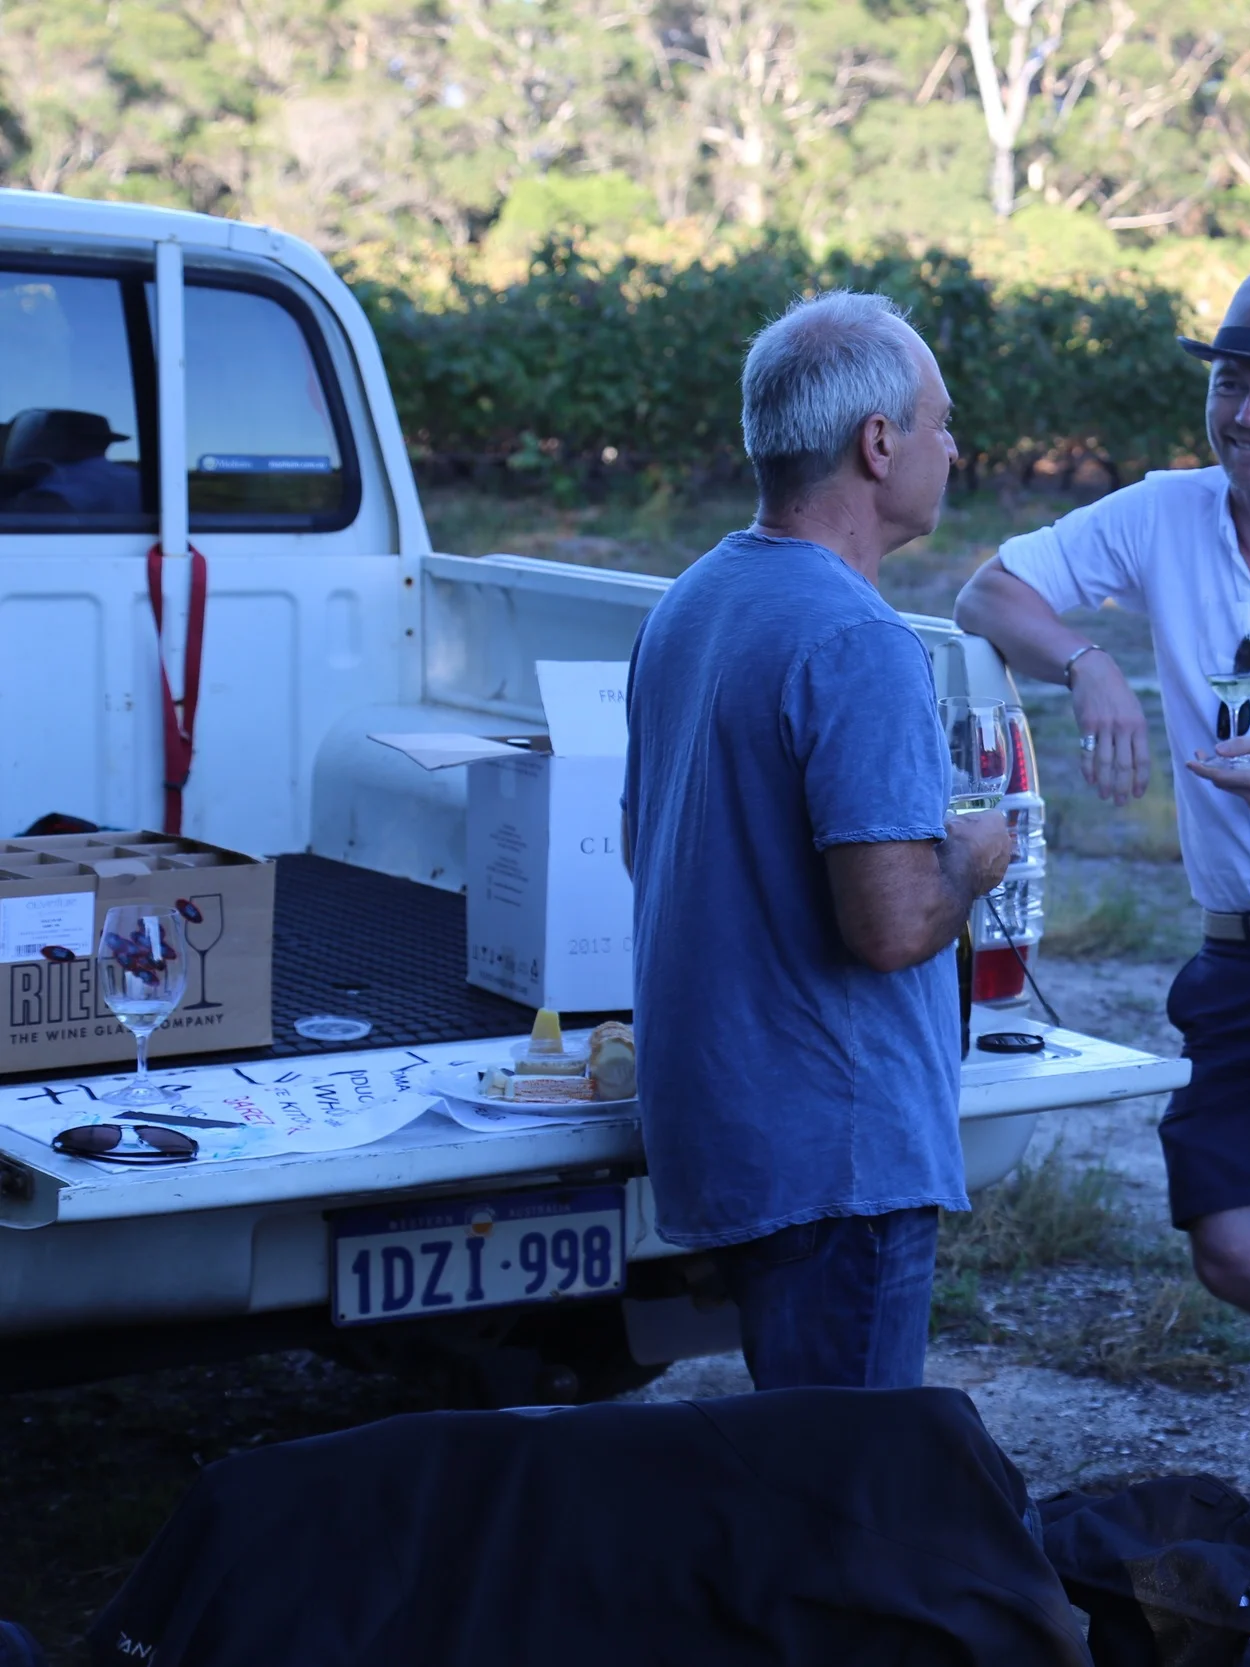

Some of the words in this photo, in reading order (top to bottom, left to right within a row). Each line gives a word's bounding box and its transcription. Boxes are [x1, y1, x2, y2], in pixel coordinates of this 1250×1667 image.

[568, 937, 611, 955] 2013
[10, 1031, 39, 1045] THE
[45, 1026, 88, 1041] WINE
